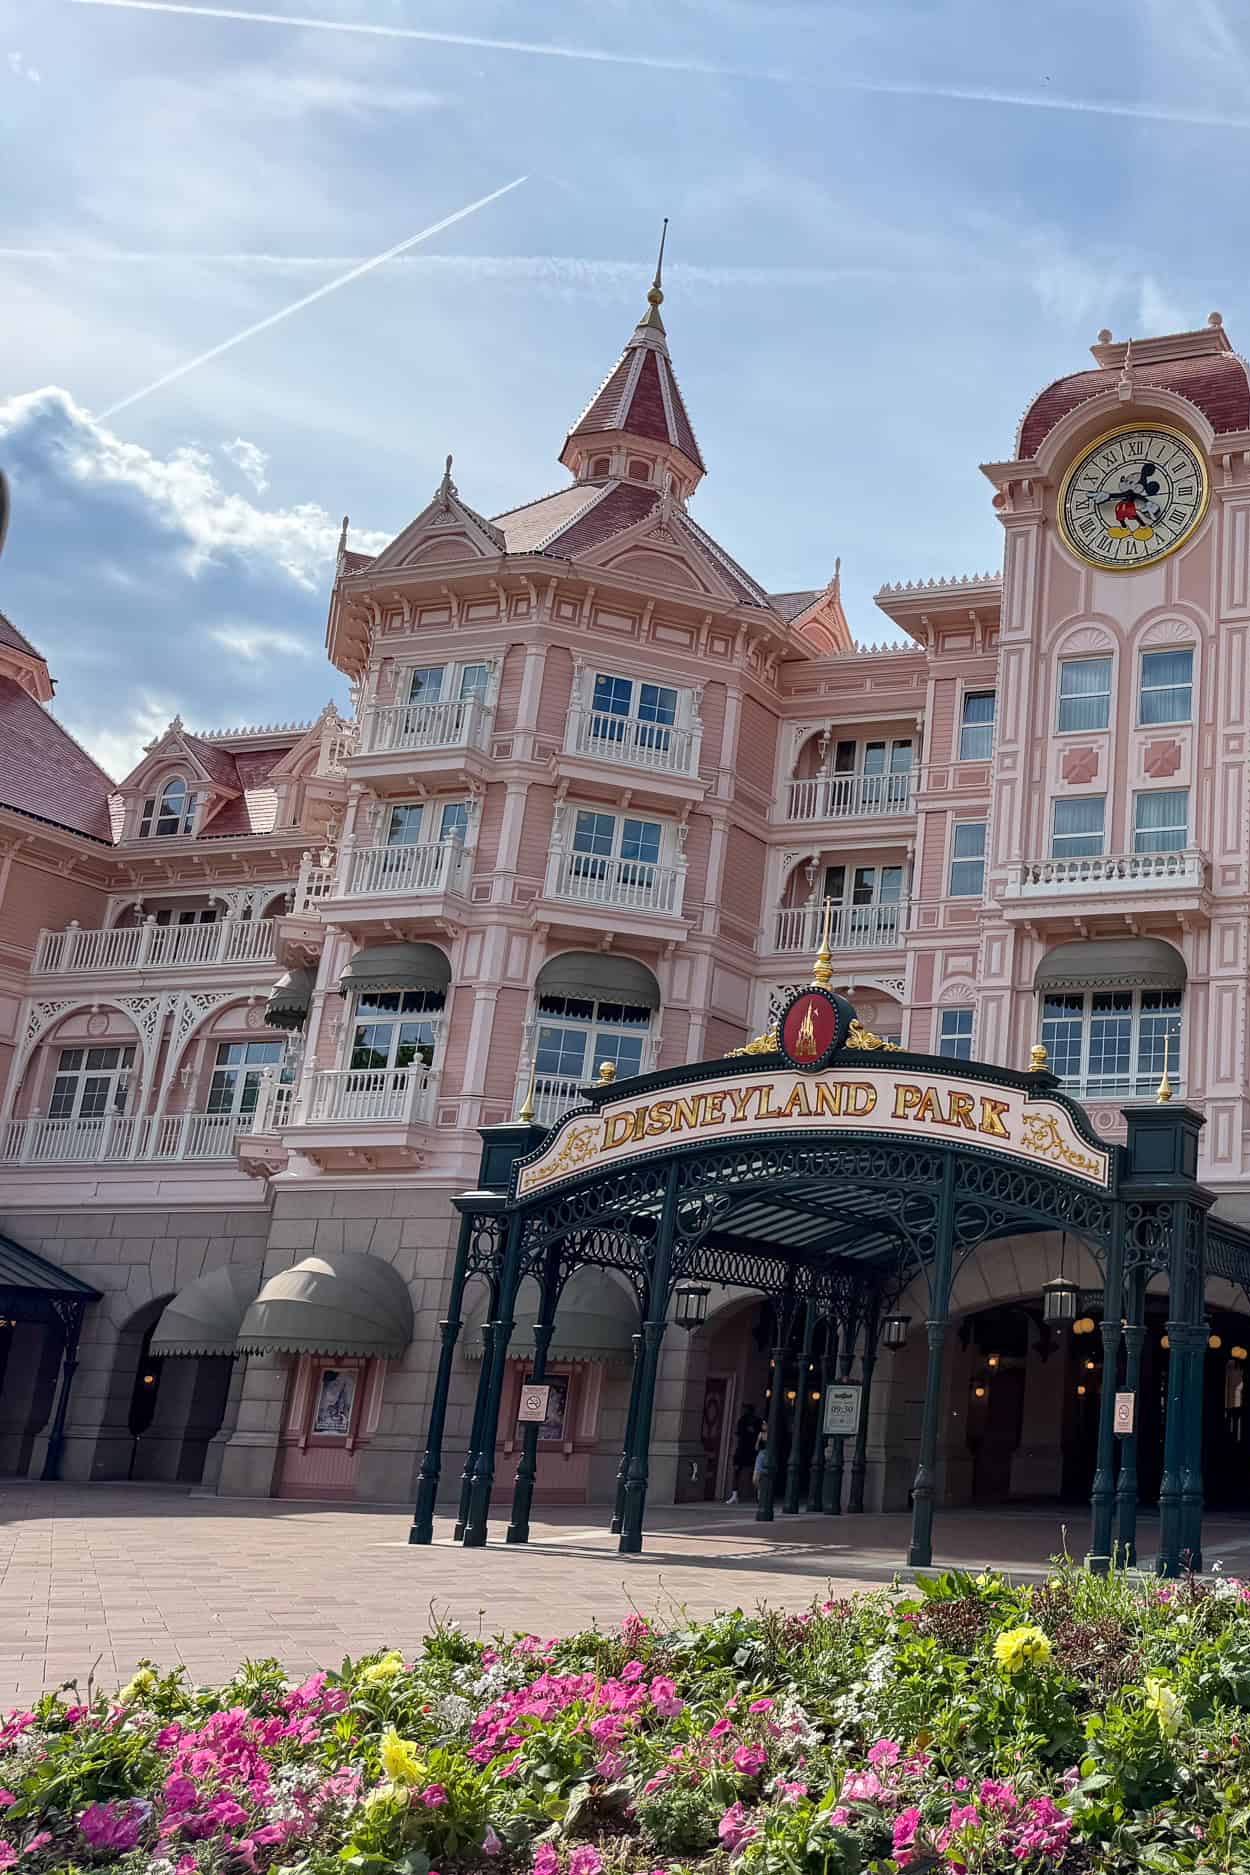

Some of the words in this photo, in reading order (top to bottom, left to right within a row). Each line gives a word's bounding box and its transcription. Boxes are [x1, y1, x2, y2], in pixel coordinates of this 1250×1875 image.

[1128, 441, 1144, 457] XII
[1157, 445, 1166, 459] I
[1102, 450, 1118, 468] XI
[1171, 461, 1187, 474] II
[1083, 473, 1099, 484] X
[1178, 486, 1193, 497] III
[1154, 532, 1165, 546] V
[1126, 541, 1138, 555] VI
[600, 1082, 878, 1151] DISNEYLAND
[891, 1084, 1011, 1139] PARK
